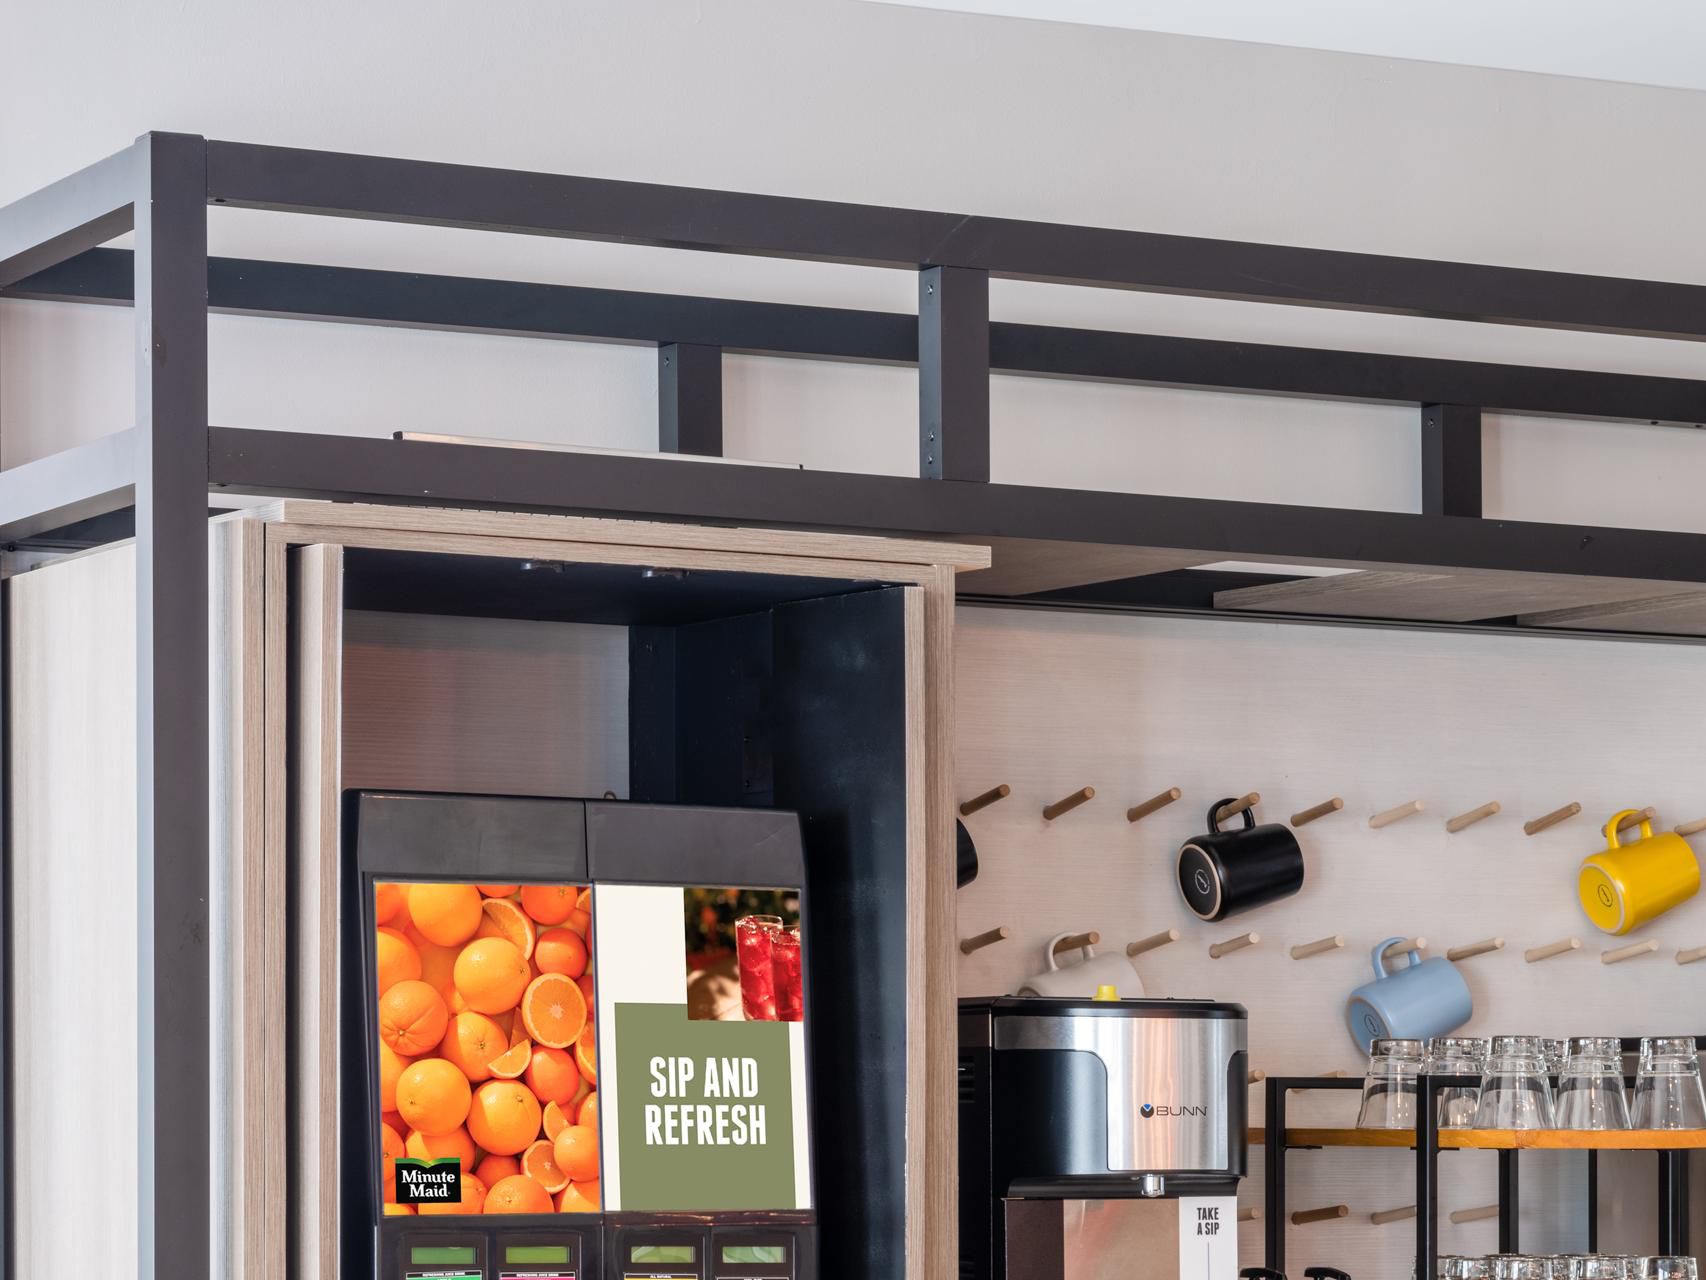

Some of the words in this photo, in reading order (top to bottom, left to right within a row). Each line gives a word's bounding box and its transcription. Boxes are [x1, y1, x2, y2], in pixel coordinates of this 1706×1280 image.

[650, 1056, 694, 1097] SIP
[704, 1057, 758, 1097] AND
[1155, 1105, 1207, 1117] BUNN
[645, 1104, 766, 1145] REFRESH
[401, 1170, 455, 1183] Minute
[409, 1183, 449, 1197] Maid
[1197, 1207, 1219, 1220] TAKE
[1197, 1222, 1203, 1235] A
[1205, 1222, 1220, 1235] SIP
